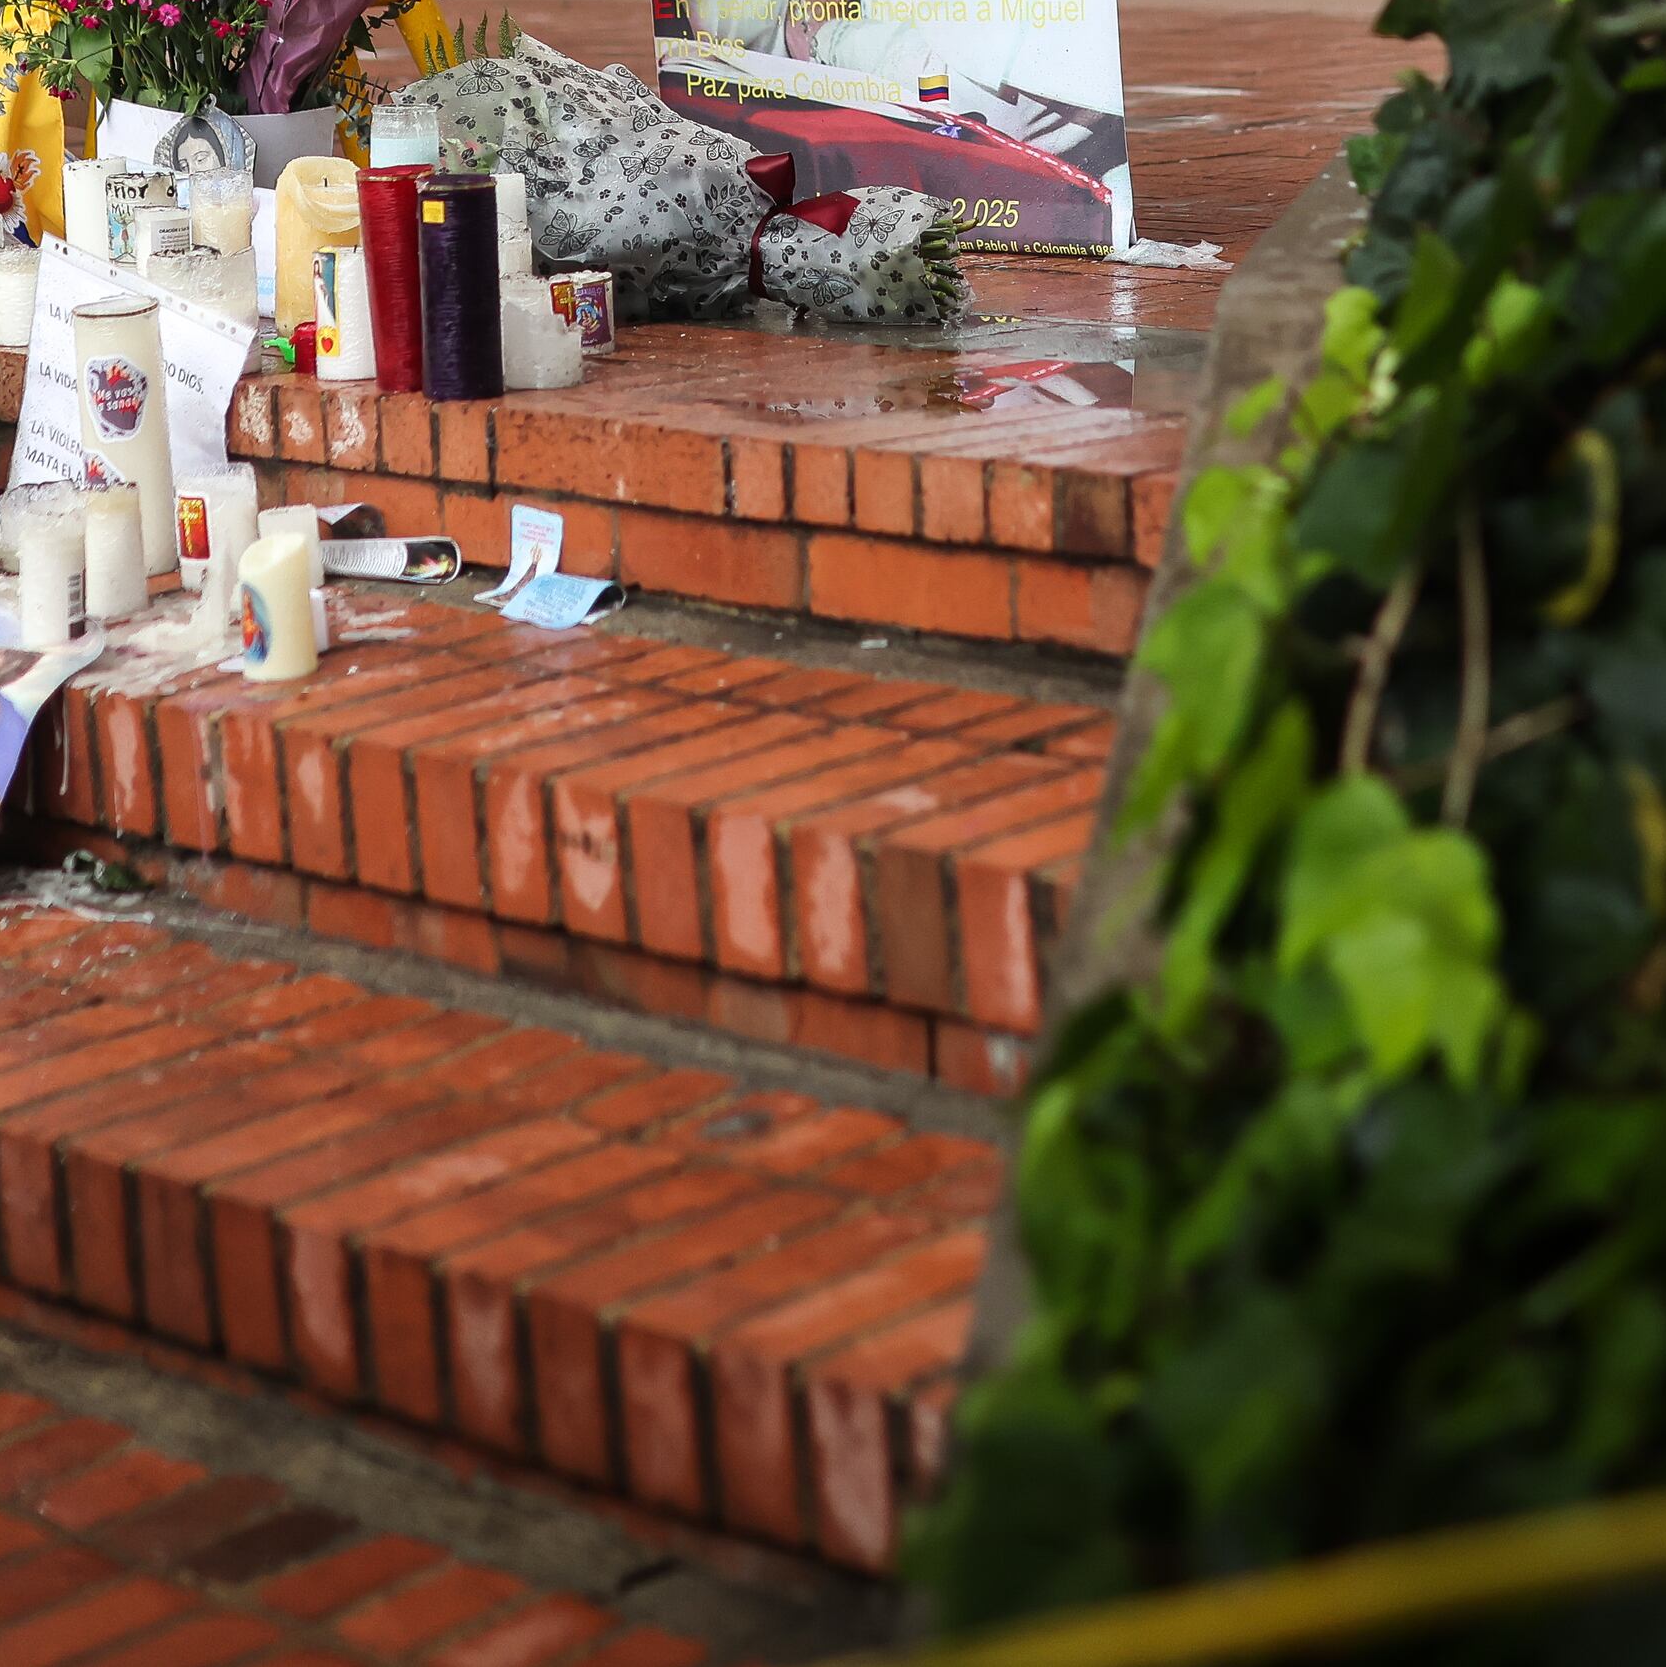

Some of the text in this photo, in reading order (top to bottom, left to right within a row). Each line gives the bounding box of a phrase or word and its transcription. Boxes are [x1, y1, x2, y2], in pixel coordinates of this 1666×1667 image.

[977, 0, 991, 22] a
[657, 30, 747, 59] mi Dios
[686, 71, 901, 105] Paz para Colombia
[976, 241, 1007, 252] Pablo
[1033, 243, 1087, 256] Colombia
[50, 303, 61, 321] LA
[39, 362, 51, 378] LA
[31, 419, 83, 457] LA VIOLEN
[25, 445, 59, 470] MATA
